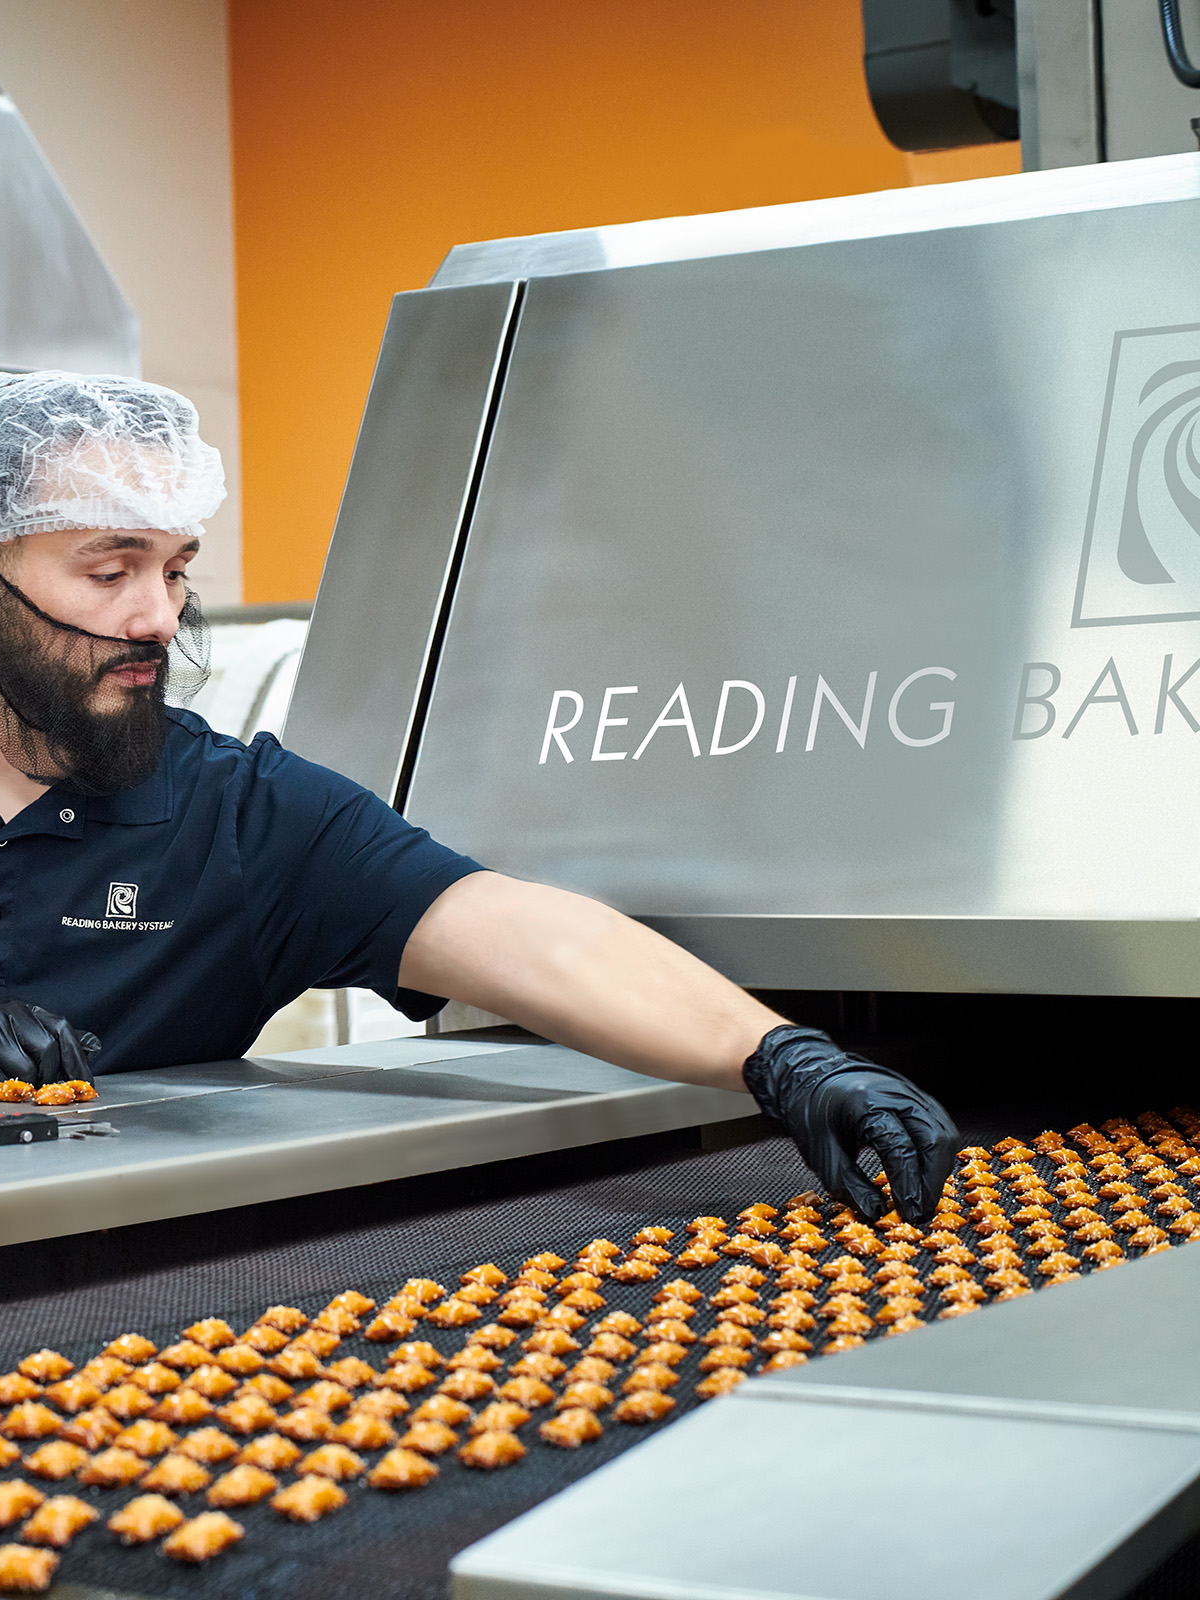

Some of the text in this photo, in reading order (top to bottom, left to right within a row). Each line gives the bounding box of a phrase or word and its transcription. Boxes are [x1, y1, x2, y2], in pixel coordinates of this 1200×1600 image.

[538, 653, 1200, 765] READING BAK
[61, 916, 101, 929] READING
[102, 920, 138, 931] BAKERY
